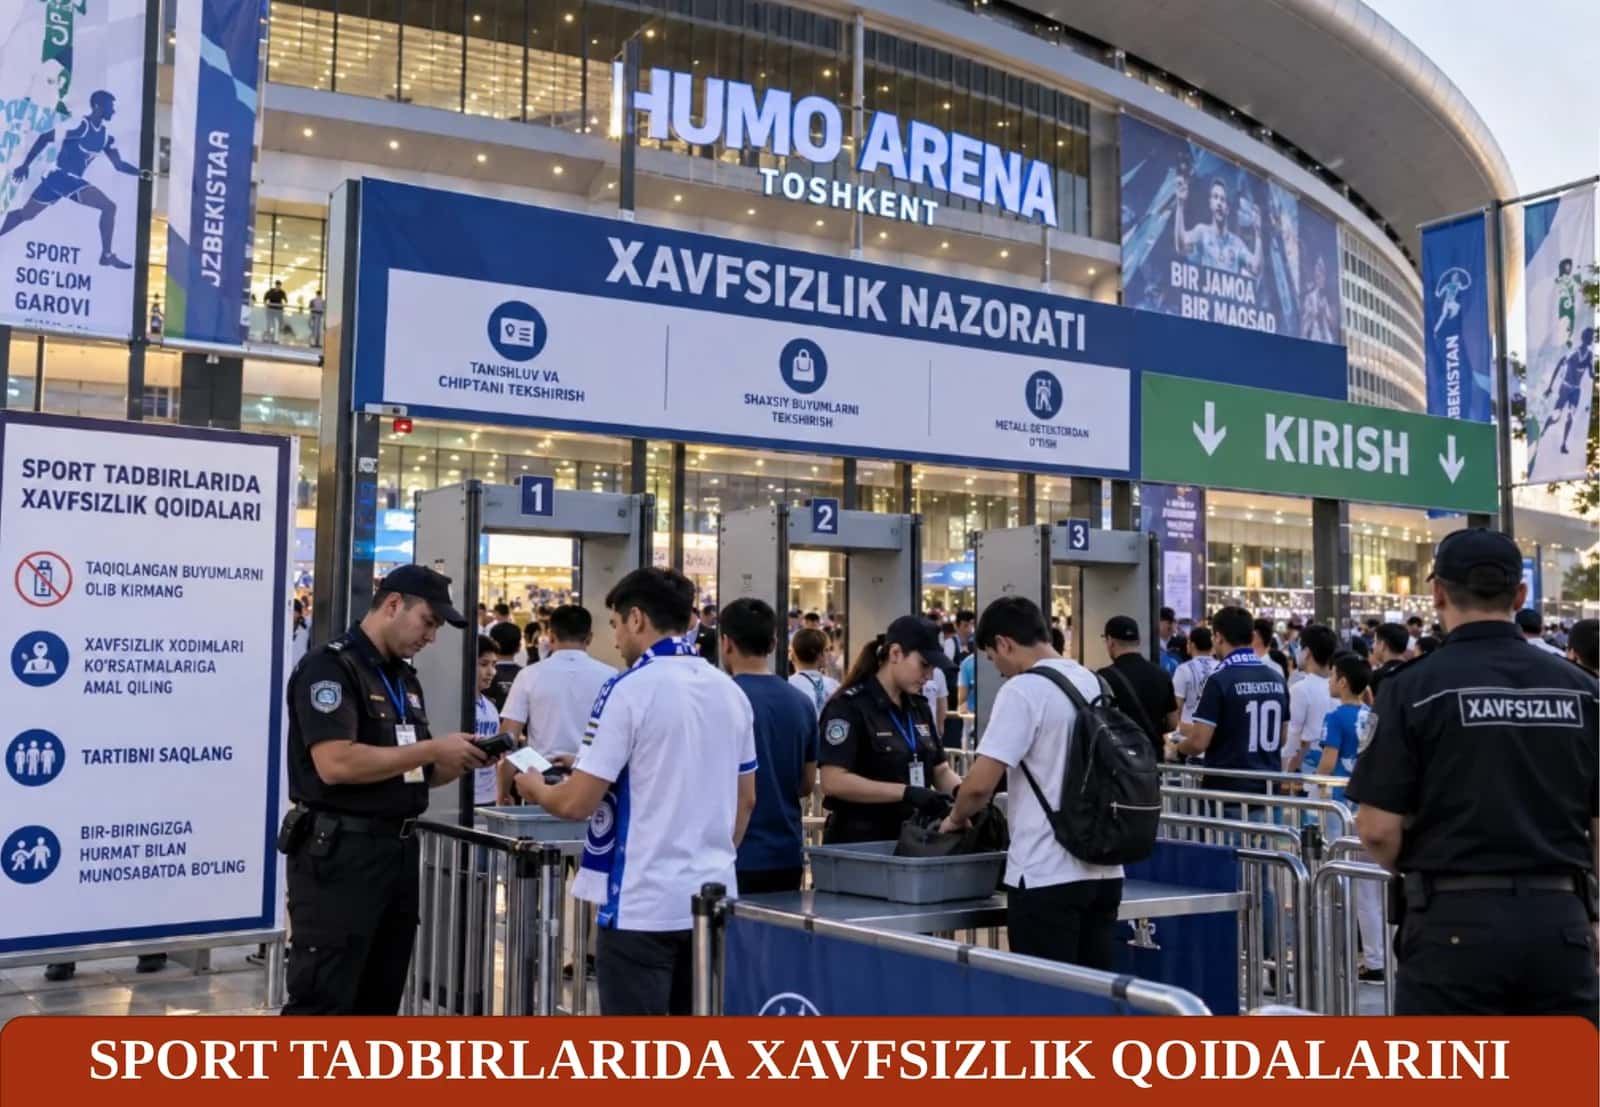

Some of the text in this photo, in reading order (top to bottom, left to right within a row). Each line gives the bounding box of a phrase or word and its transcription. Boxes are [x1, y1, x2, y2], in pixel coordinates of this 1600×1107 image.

[612, 61, 1057, 226] HUMO ARENA
[760, 167, 938, 226] TOSHKENT
[26, 241, 80, 264] SPORT
[606, 236, 1086, 352] XAVFSIZLIK NAZORATI
[1171, 261, 1255, 304] BIR JAMOA
[15, 291, 90, 317] GAROVI
[1181, 294, 1209, 321] BIR
[470, 361, 560, 383] TANISHLUV VA
[1446, 334, 1461, 420] BEKISTAN
[439, 375, 585, 402] CHIPTANI TEKSHIRISH
[744, 393, 859, 416] SHAXSIY BUYUMLARNI
[772, 412, 833, 427] TEKSHIRISH
[995, 420, 1028, 432] METALL
[1265, 413, 1409, 476] KIRISH
[22, 458, 261, 494] SPORT TADBIRLARIDA
[21, 488, 261, 521] XAVFSIZLIK QOIDALARI
[530, 483, 543, 512] 1
[817, 506, 832, 530] 2
[1073, 525, 1085, 548] 3
[86, 561, 264, 581] TAQIQLANGAN BUYUMLARNI
[86, 582, 183, 598] OLIB KIRMANG
[85, 638, 244, 653] XAVFSIZLIK XODIMLARI
[83, 680, 172, 696] AMAL QILING
[1467, 698, 1576, 720] XAVFSIZLIK
[1246, 700, 1282, 752] 10
[82, 746, 233, 765] TARTIBNI SAQLANG
[80, 821, 192, 840] BIR-BIRINGIZGA
[80, 842, 186, 862] HURMAT BILAN
[79, 863, 186, 884] MUNOSABATDA
